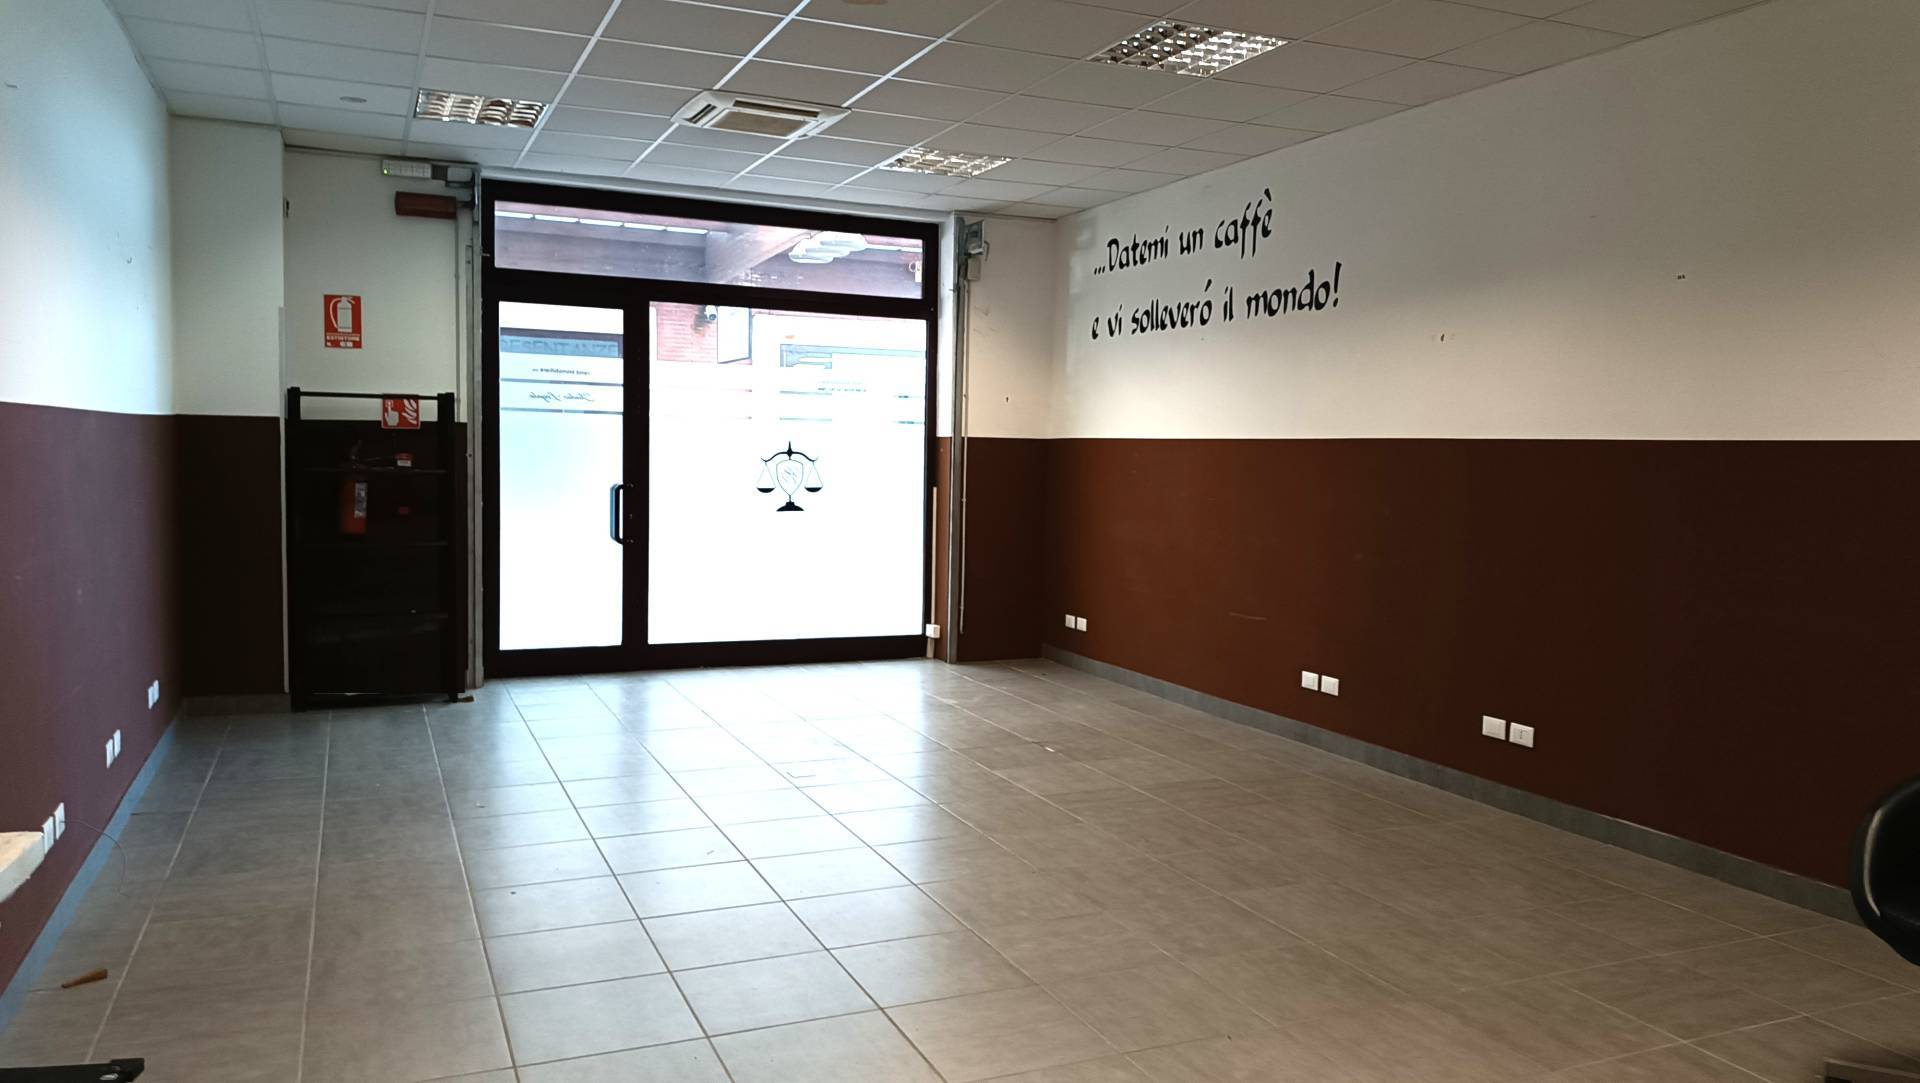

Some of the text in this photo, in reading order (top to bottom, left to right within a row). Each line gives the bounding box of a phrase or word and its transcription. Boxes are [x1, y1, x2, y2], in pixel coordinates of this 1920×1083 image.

[1179, 229, 1204, 256] un
[1214, 188, 1273, 259] caffè
[1091, 316, 1099, 340] e
[1108, 304, 1122, 337] vi
[1223, 286, 1234, 323] il
[1246, 261, 1342, 320] mondo!
